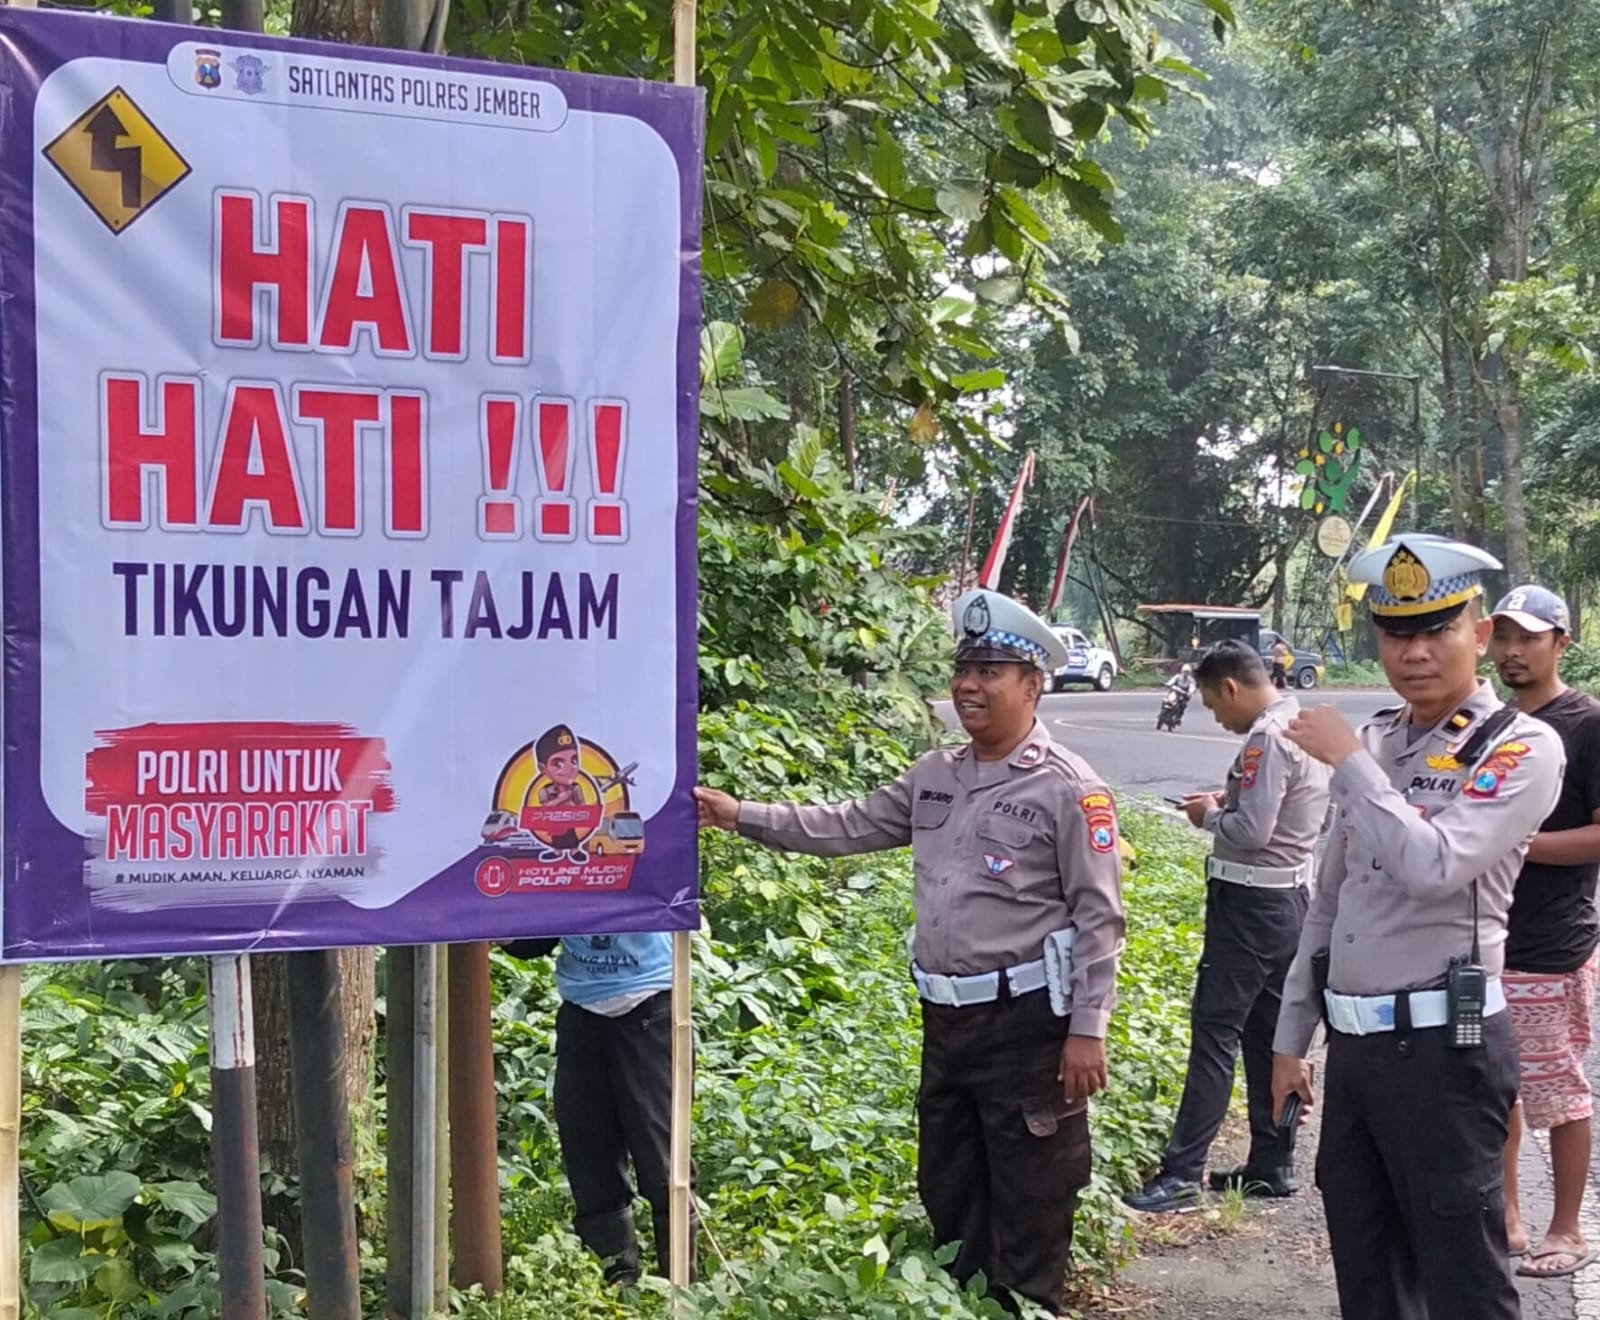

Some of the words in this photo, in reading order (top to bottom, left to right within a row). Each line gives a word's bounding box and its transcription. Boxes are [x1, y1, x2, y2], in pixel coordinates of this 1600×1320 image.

[288, 65, 395, 104] SATLANTAS
[400, 77, 469, 112] POLRES
[473, 86, 541, 119] JEMBER
[216, 192, 532, 361] HATI
[102, 374, 427, 536] HATI
[480, 396, 627, 541] !!!
[112, 562, 410, 639] TIKUNGAN
[430, 569, 620, 641] TAJAM
[137, 749, 229, 796] POLRI
[240, 748, 343, 794] UNTUK
[1410, 776, 1456, 793] POLRI
[531, 810, 591, 822] PRESISI
[993, 800, 1036, 823] POLRI
[105, 799, 374, 863] MASYARAKAT
[128, 872, 176, 884] MUDIK
[230, 868, 302, 881] KELUARGA
[306, 867, 365, 879] NYAMAN
[518, 865, 580, 876] HOTLINE
[583, 864, 628, 875] MUDIK
[518, 876, 572, 886] POLRI
